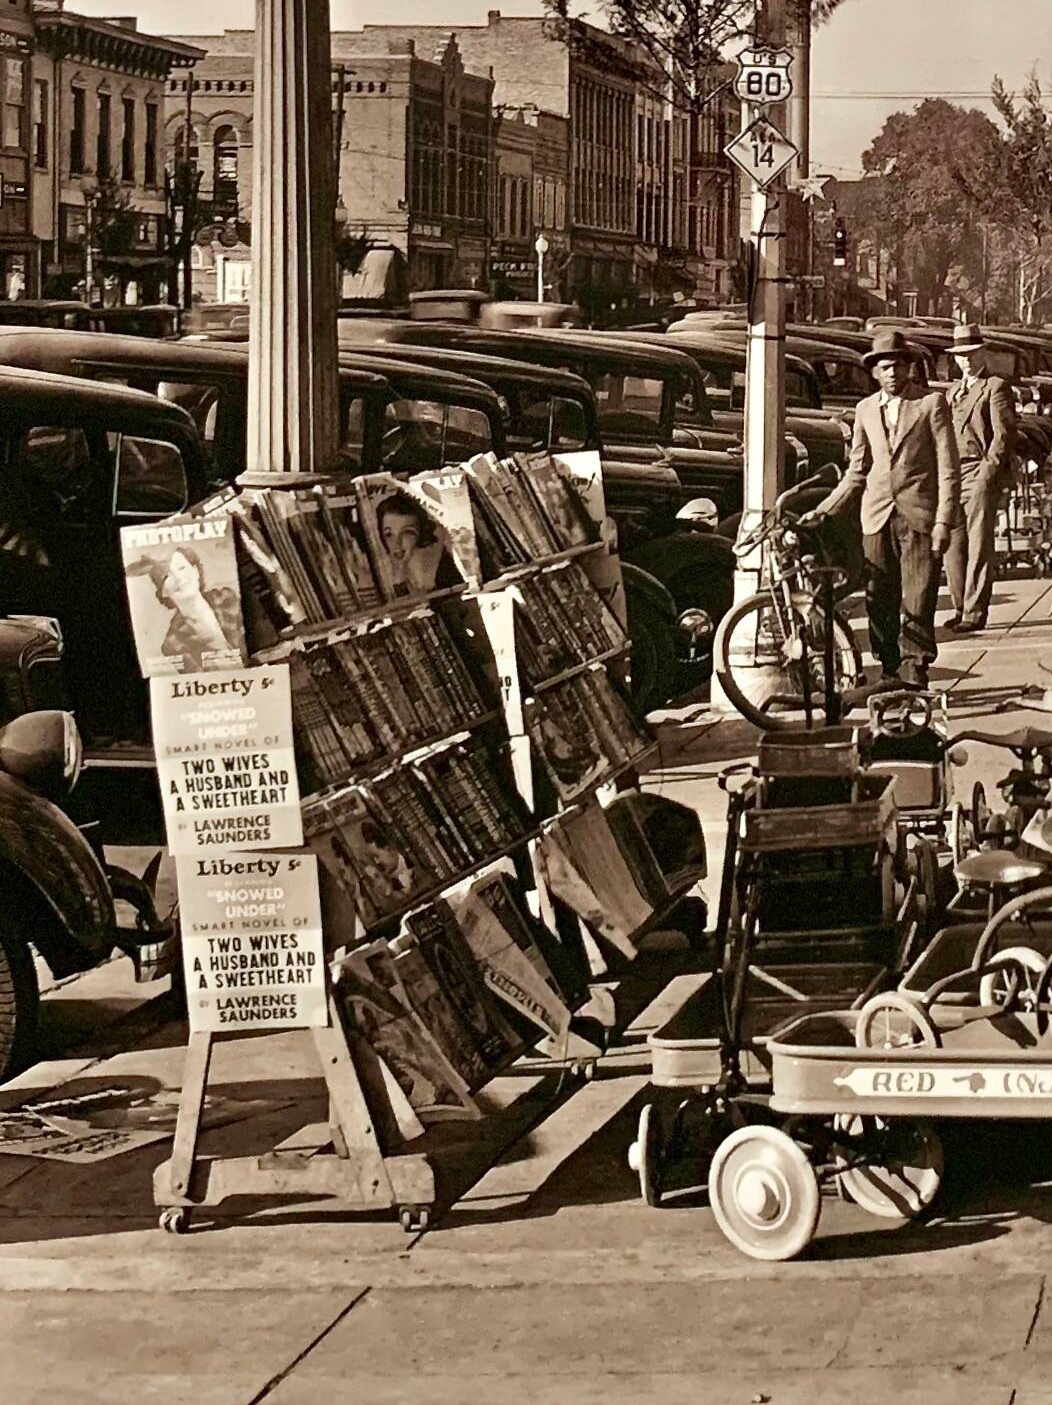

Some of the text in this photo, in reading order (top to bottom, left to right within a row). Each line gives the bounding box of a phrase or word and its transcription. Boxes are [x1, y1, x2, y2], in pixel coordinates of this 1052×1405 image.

[747, 71, 781, 96] 80
[751, 144, 774, 168] 14
[171, 678, 254, 698] Liberty
[215, 739, 257, 751] NOVEL
[264, 736, 279, 747] OF
[182, 753, 270, 775] TWO WIVES
[170, 770, 289, 794] A HUSBAND AND
[177, 787, 287, 811] A SWEETHEART
[194, 815, 271, 833] LAWRENCE
[197, 828, 271, 845] SAUNDERS
[197, 859, 280, 877] Liberty
[192, 917, 308, 932] SMART NOVEL OF
[208, 933, 298, 953] TWO WIVES
[193, 951, 315, 972] A HUSBAND AND
[199, 968, 312, 989] A SWEETHEART
[217, 994, 297, 1010] LAWRENCE
[220, 1007, 297, 1023] SAUNDERS
[872, 1072, 935, 1093] RED
